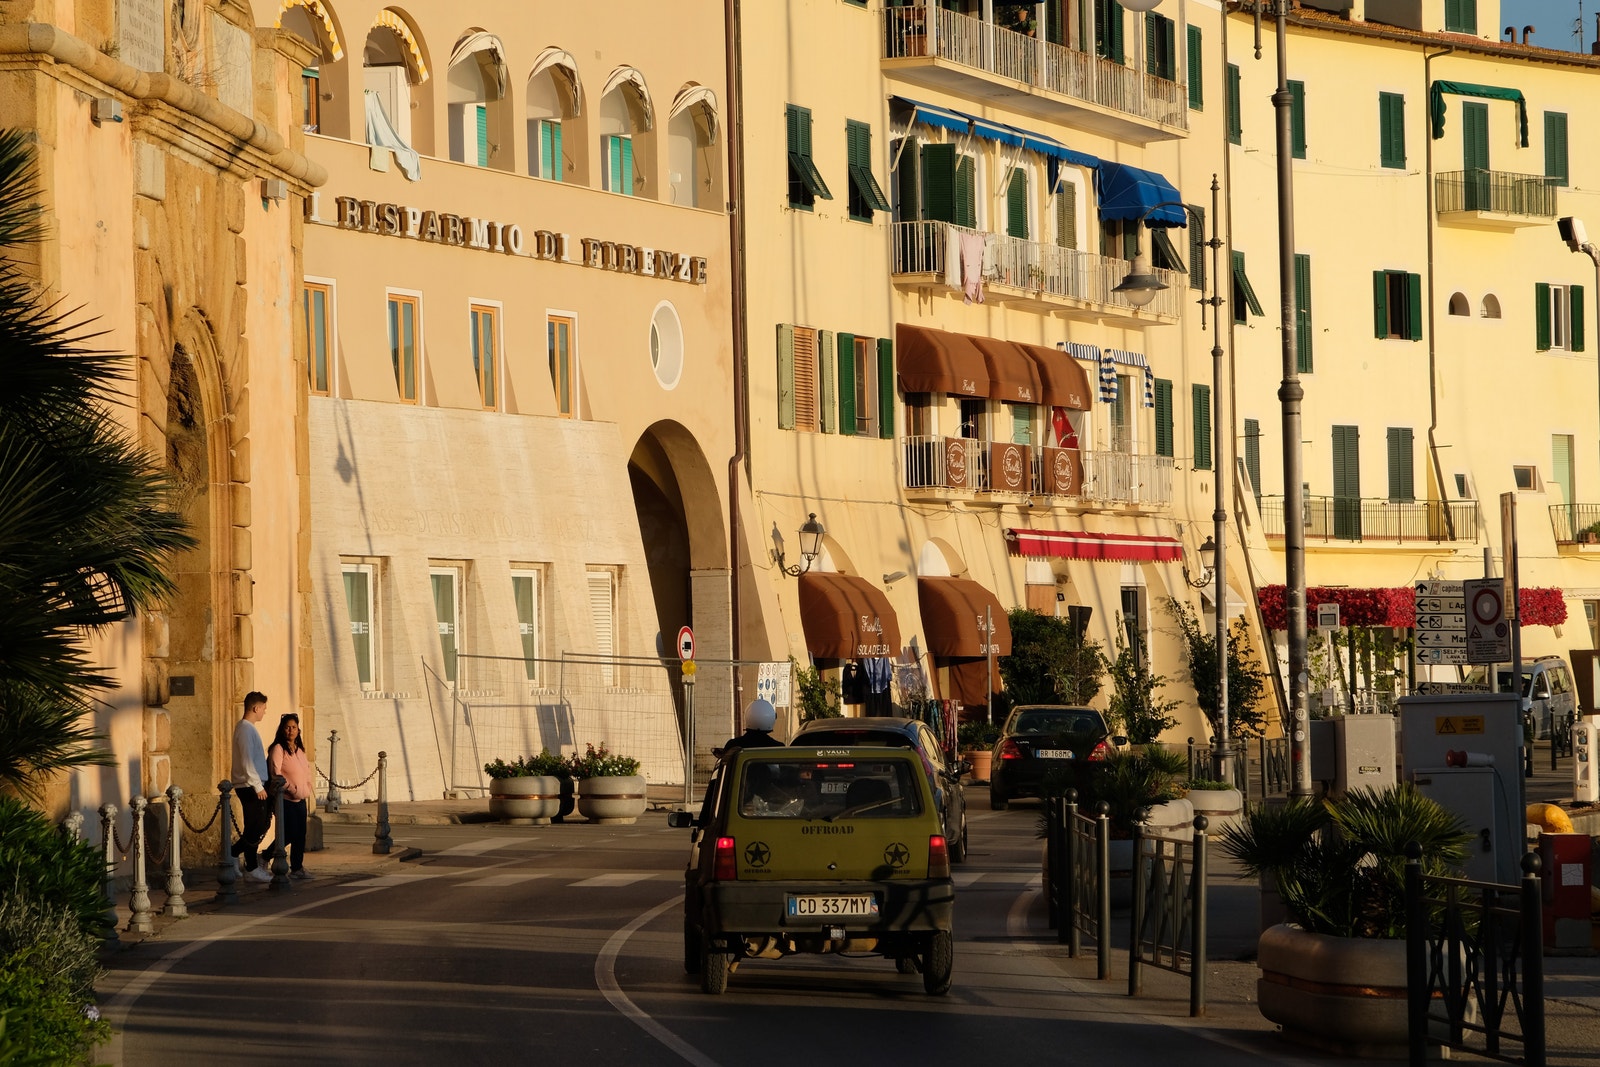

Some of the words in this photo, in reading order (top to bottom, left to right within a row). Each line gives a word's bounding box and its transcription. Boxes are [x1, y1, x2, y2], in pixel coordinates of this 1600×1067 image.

[336, 196, 524, 255] RISPARMIO
[535, 229, 570, 262] DI
[581, 238, 707, 285] FIRENZE
[801, 825, 855, 835] OFFROAD
[799, 899, 817, 914] CD
[822, 898, 868, 914] 337MY
